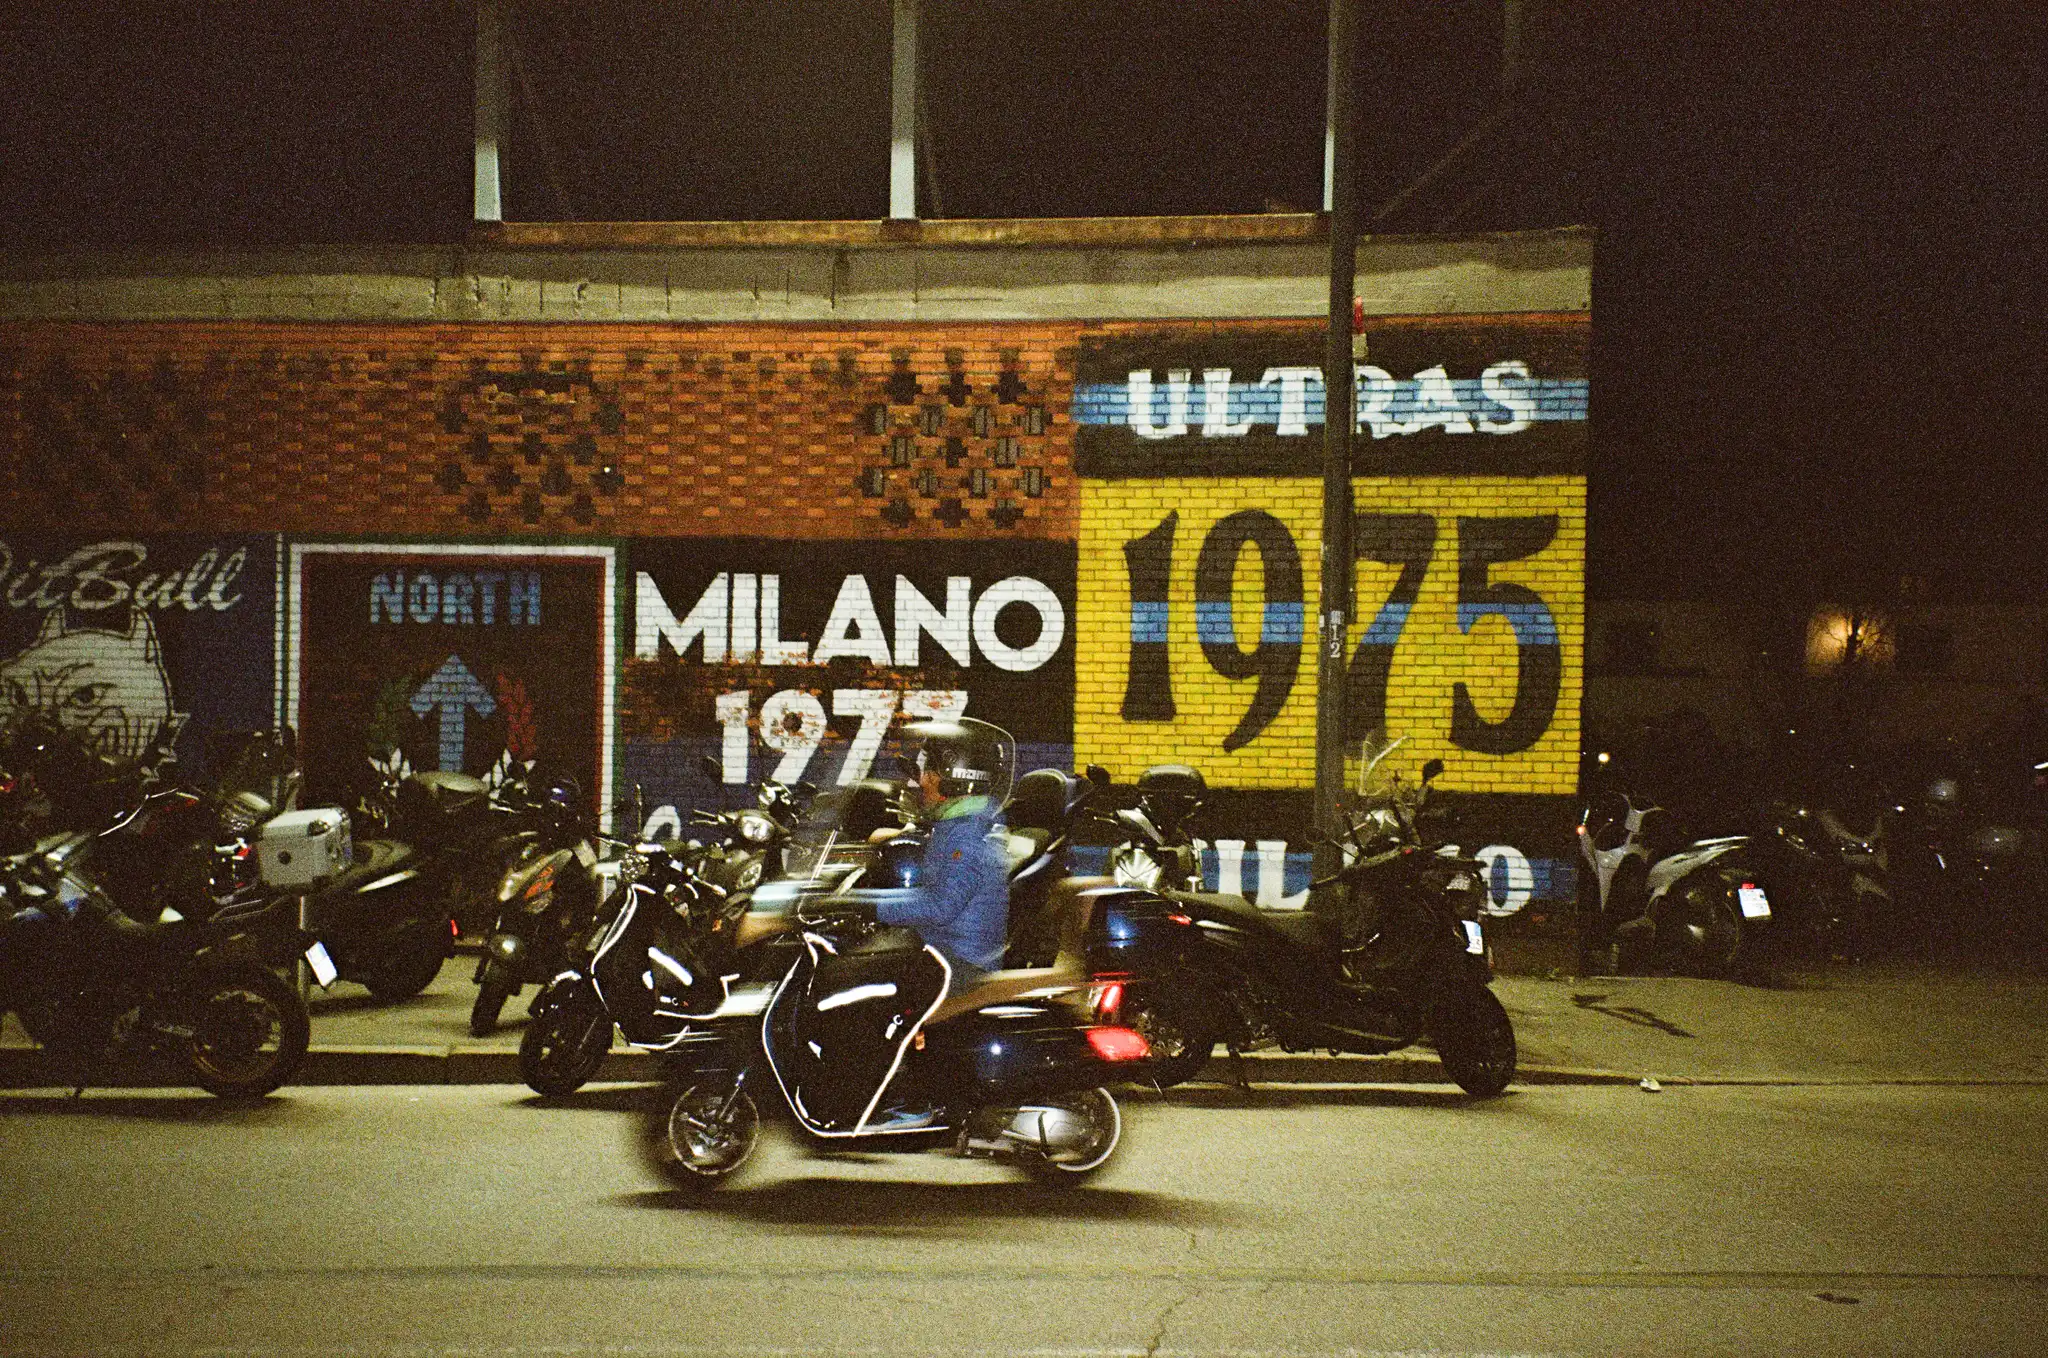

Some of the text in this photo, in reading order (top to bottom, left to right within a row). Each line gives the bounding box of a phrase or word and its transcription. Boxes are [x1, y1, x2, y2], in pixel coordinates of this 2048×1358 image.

[1128, 360, 1536, 439] ULTRAS
[370, 571, 541, 625] NORTH
[635, 571, 1065, 672] MILANO
[1120, 508, 1562, 755] 1975
